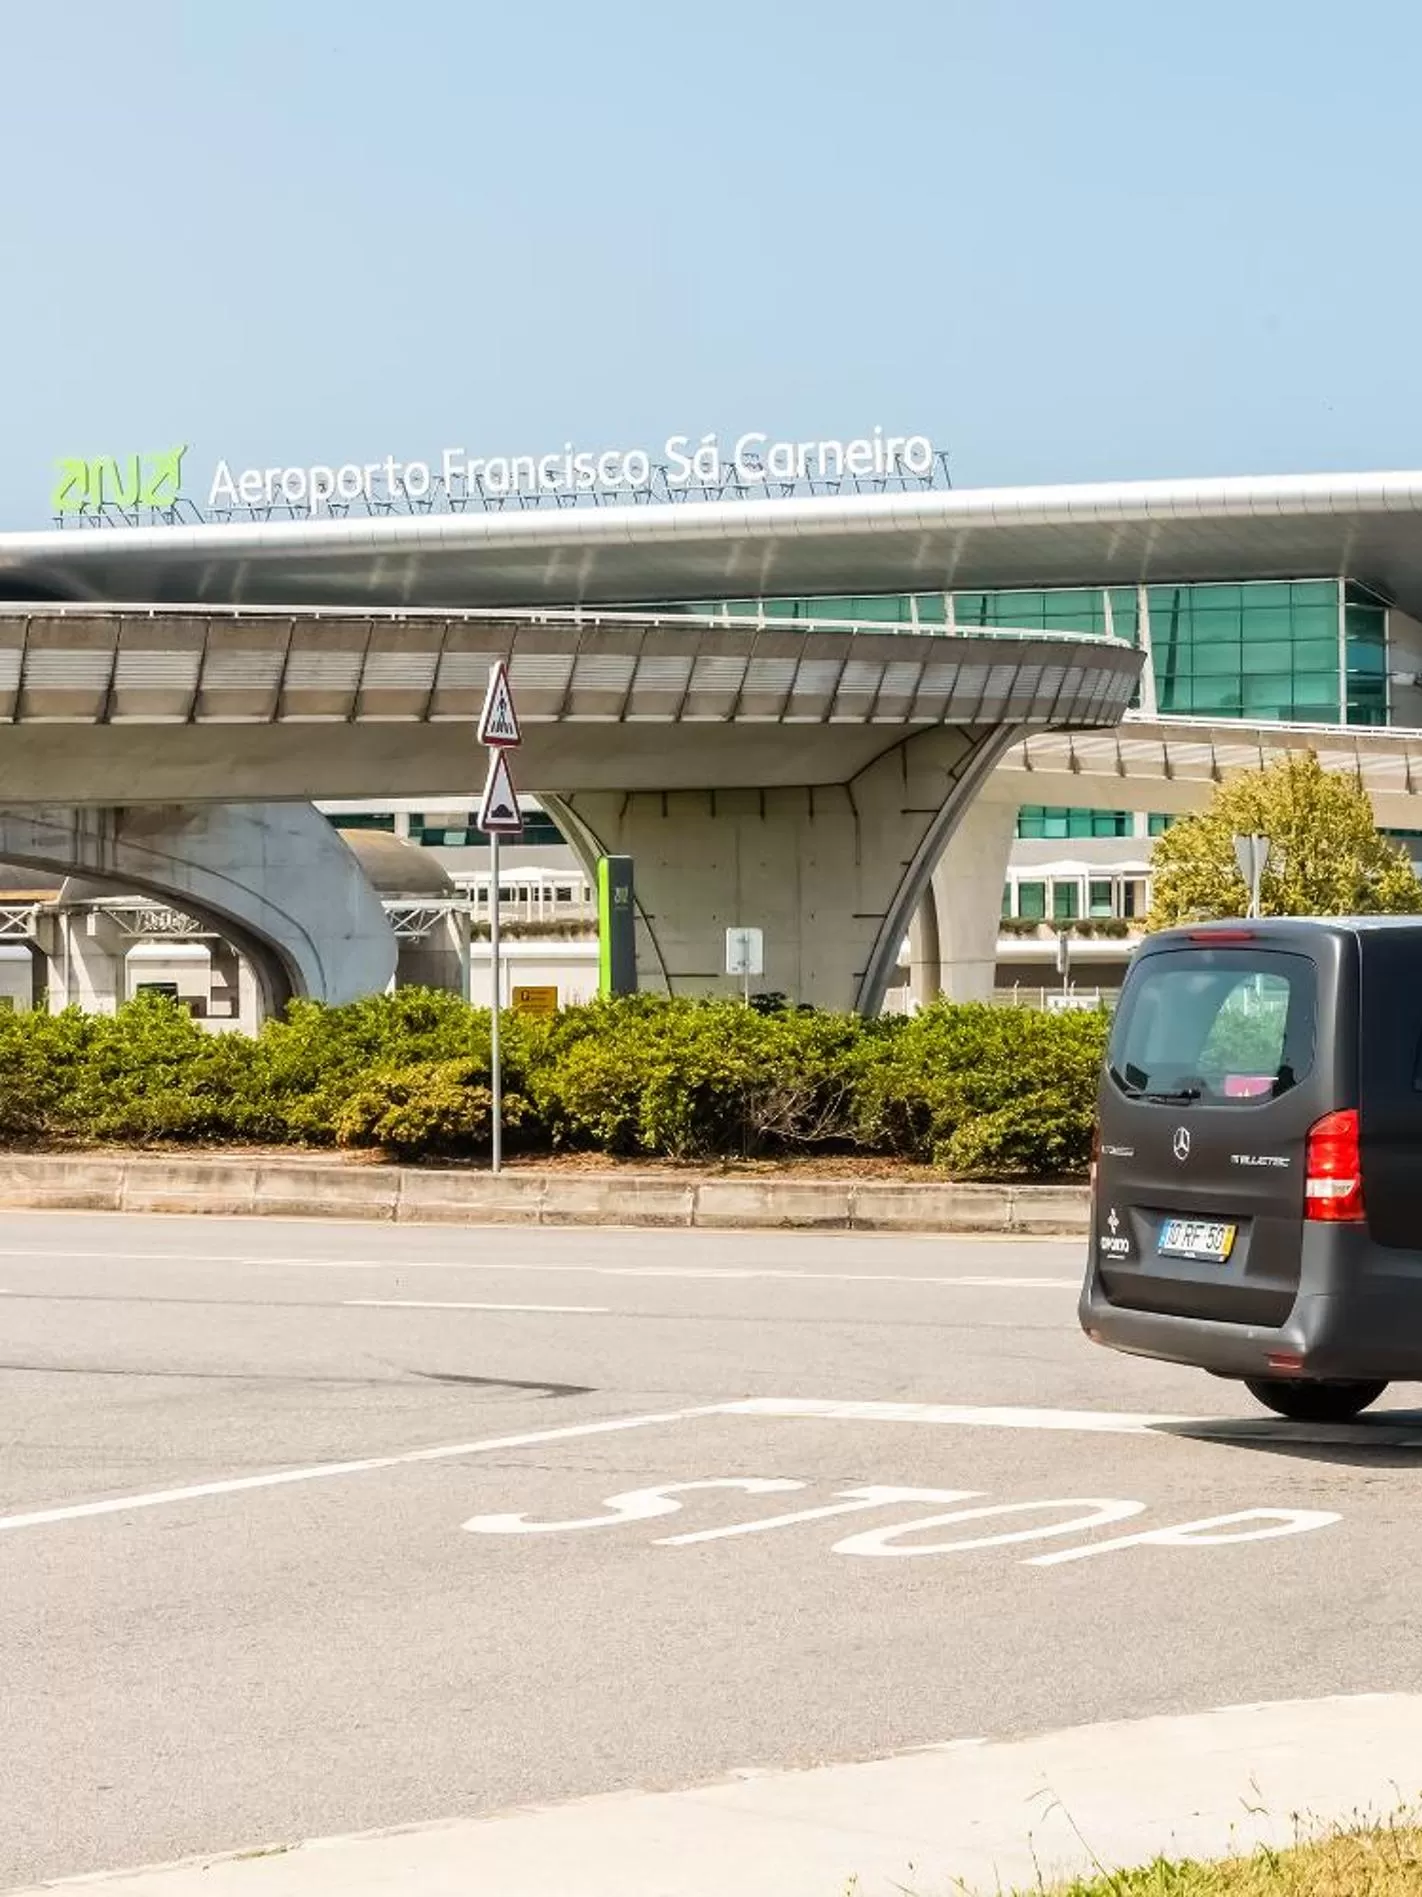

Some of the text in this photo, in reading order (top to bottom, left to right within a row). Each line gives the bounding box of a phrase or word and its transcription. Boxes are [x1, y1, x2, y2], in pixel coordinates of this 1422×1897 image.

[208, 425, 932, 515] Aeroporto Francisco Sá Carneiro
[460, 1478, 1343, 1567] STOP
